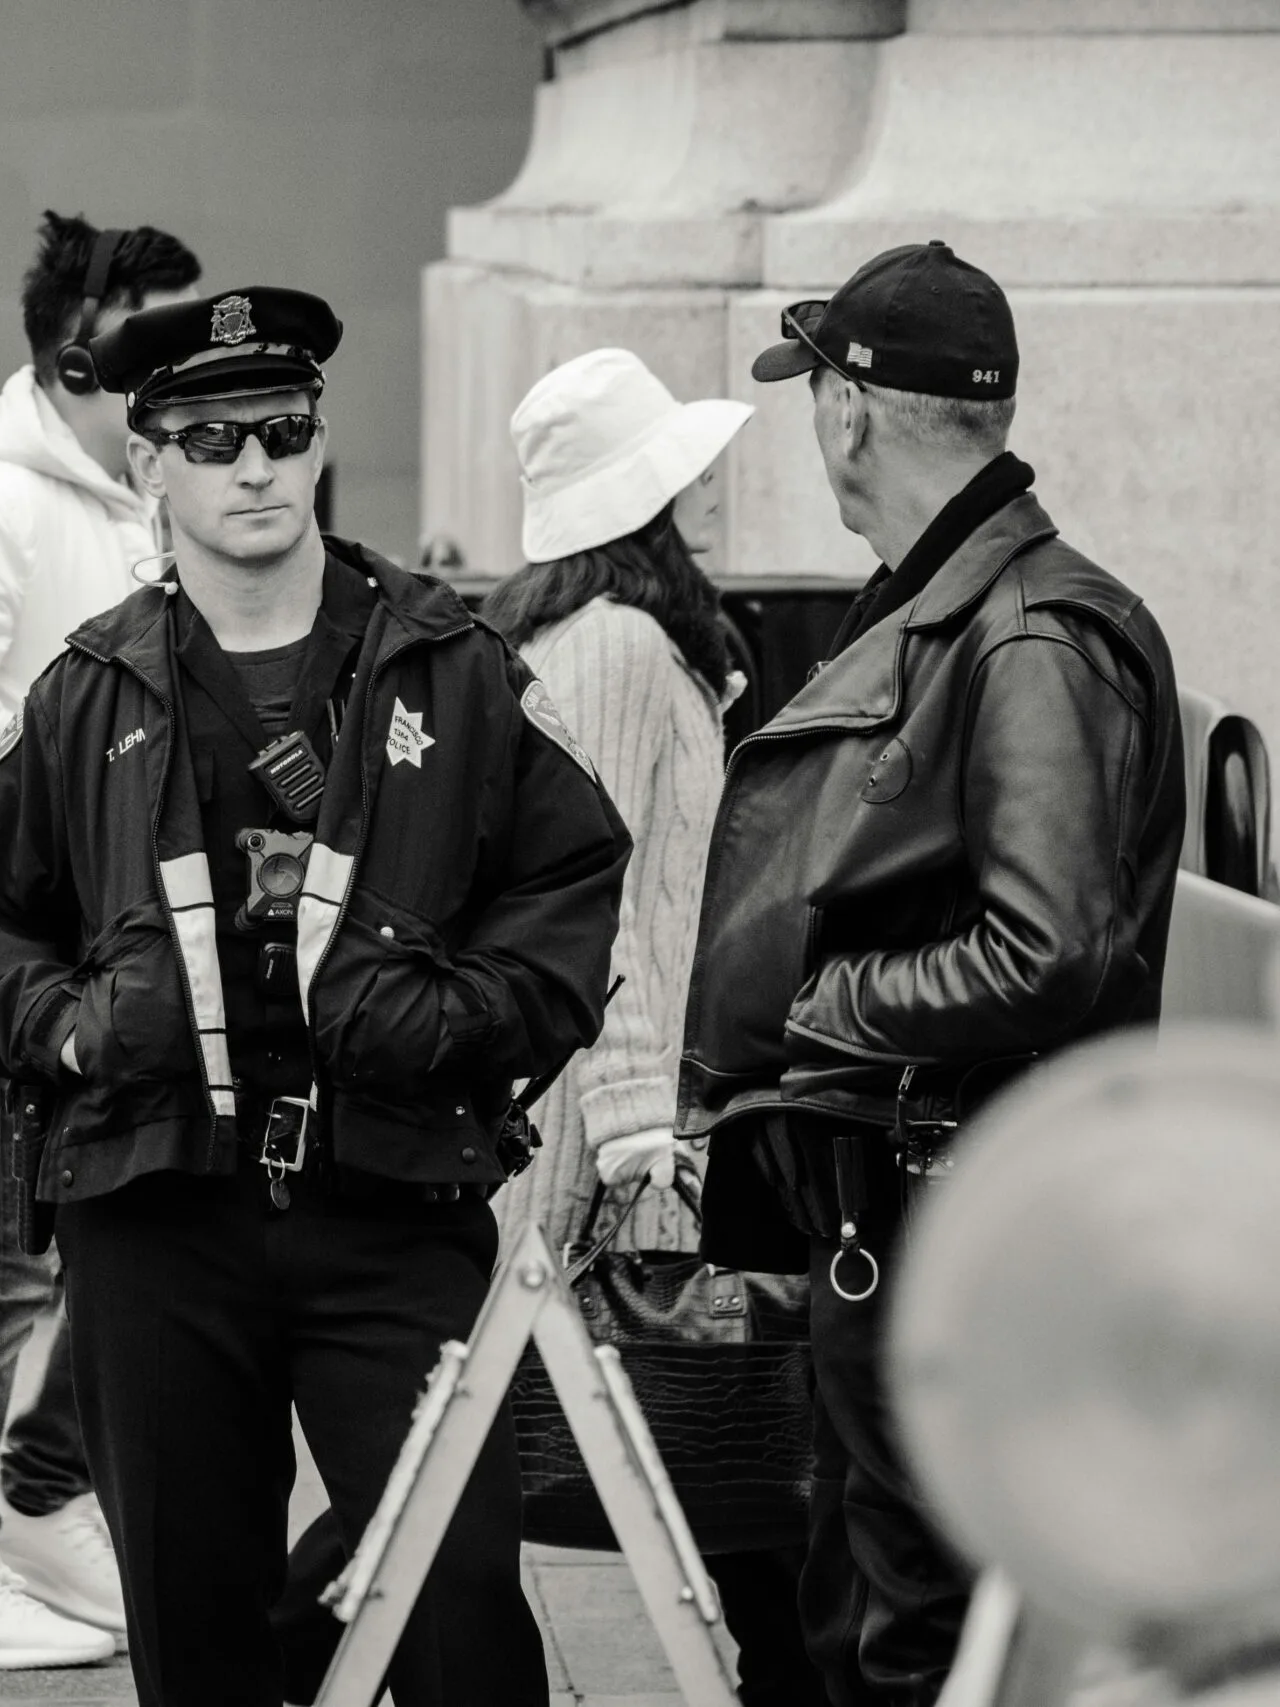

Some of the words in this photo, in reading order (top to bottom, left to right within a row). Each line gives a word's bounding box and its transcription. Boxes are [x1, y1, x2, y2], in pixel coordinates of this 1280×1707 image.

[972, 369, 1000, 384] 941
[395, 715, 423, 746] FRANCISCO
[270, 749, 303, 774] MOTOROLA
